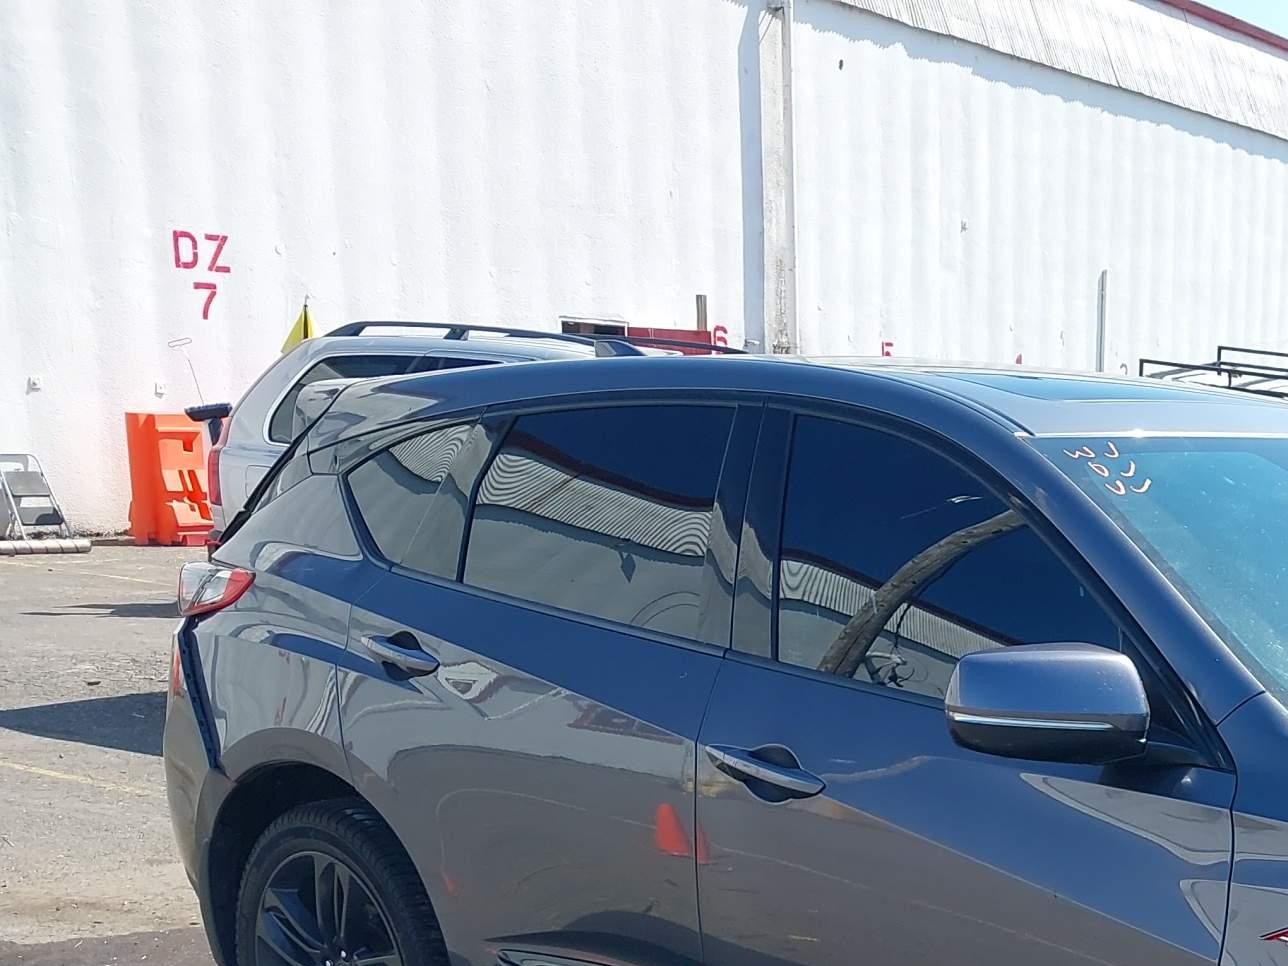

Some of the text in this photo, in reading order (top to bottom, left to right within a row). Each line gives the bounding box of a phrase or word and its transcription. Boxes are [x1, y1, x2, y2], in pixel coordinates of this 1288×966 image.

[172, 230, 231, 273] DZ
[193, 282, 218, 320] 7
[713, 324, 728, 355] 6
